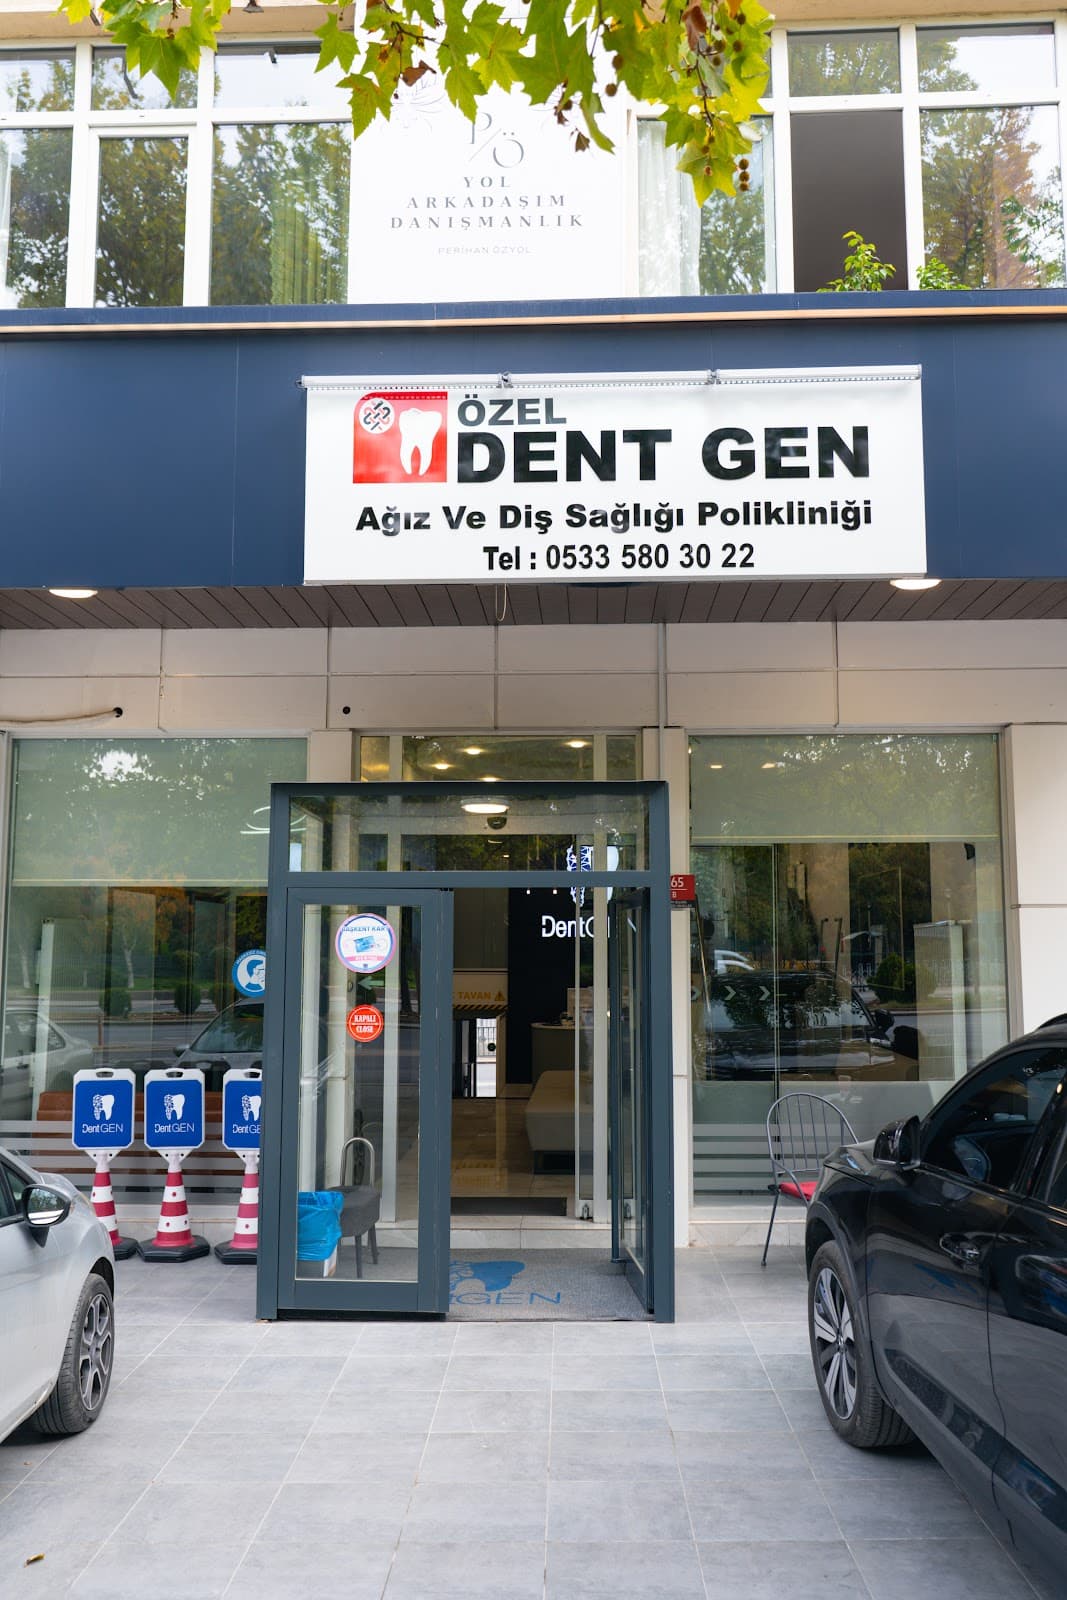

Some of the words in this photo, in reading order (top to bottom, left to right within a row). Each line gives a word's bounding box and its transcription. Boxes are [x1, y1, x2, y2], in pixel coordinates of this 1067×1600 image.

[463, 176, 511, 189] YOL
[407, 194, 566, 210] ARKADAŞIM
[390, 214, 584, 231] DANIŞMANLIK
[457, 394, 567, 426] ÖZEL
[457, 428, 673, 483] DENT
[701, 425, 870, 480] GEN
[355, 504, 431, 537] Ağız
[442, 505, 486, 530] Ve
[499, 503, 553, 535] Diş
[565, 502, 685, 534] Sağlığı
[698, 500, 873, 532] Polikliniği
[483, 545, 521, 571] Tel
[545, 544, 611, 570] 0533
[621, 543, 670, 569] 580
[679, 543, 711, 569] 30
[721, 542, 755, 569] 22
[670, 876, 685, 888] 65
[456, 991, 491, 1001] TAVAN
[81, 1122, 124, 1135] DentGEN
[154, 1122, 195, 1134] DentGEN
[232, 1123, 262, 1134] DentGE
